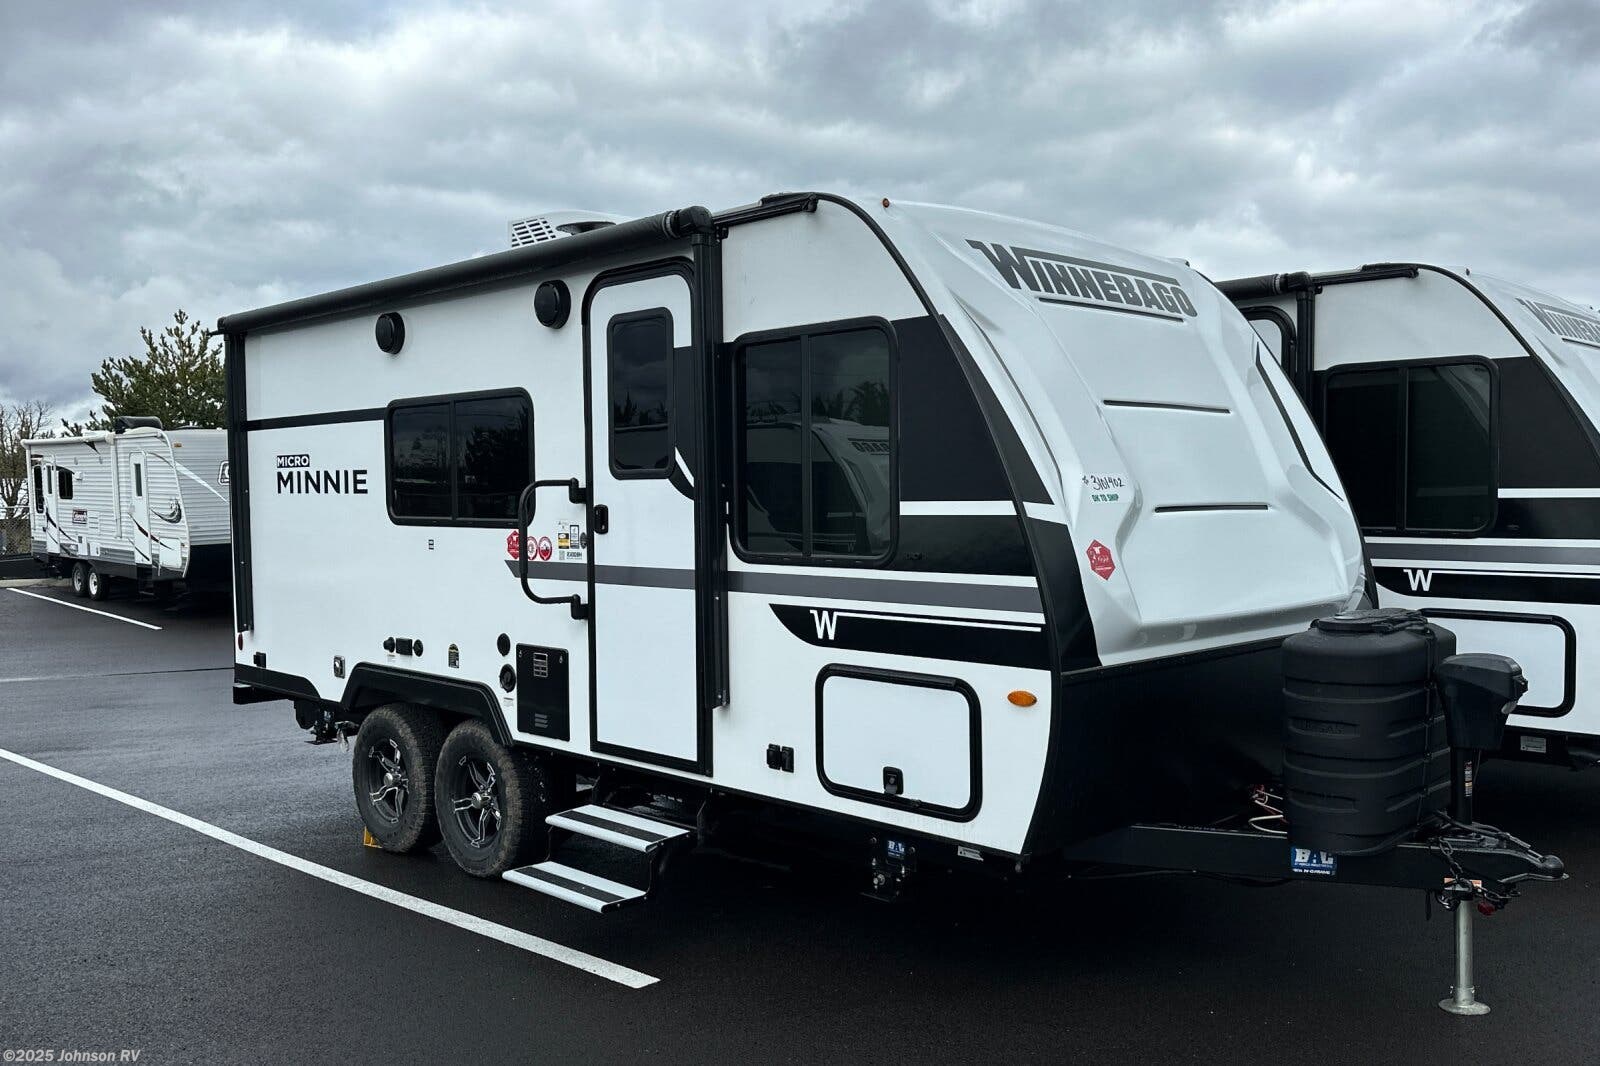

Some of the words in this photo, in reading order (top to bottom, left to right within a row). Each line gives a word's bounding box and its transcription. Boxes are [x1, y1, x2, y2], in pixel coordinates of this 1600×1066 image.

[965, 239, 1198, 317] WINNEBAGO
[1515, 297, 1600, 344] WINNEB
[277, 455, 309, 467] MICRO
[277, 470, 368, 494] MINNIE
[1404, 568, 1434, 592] W
[810, 609, 838, 640] W
